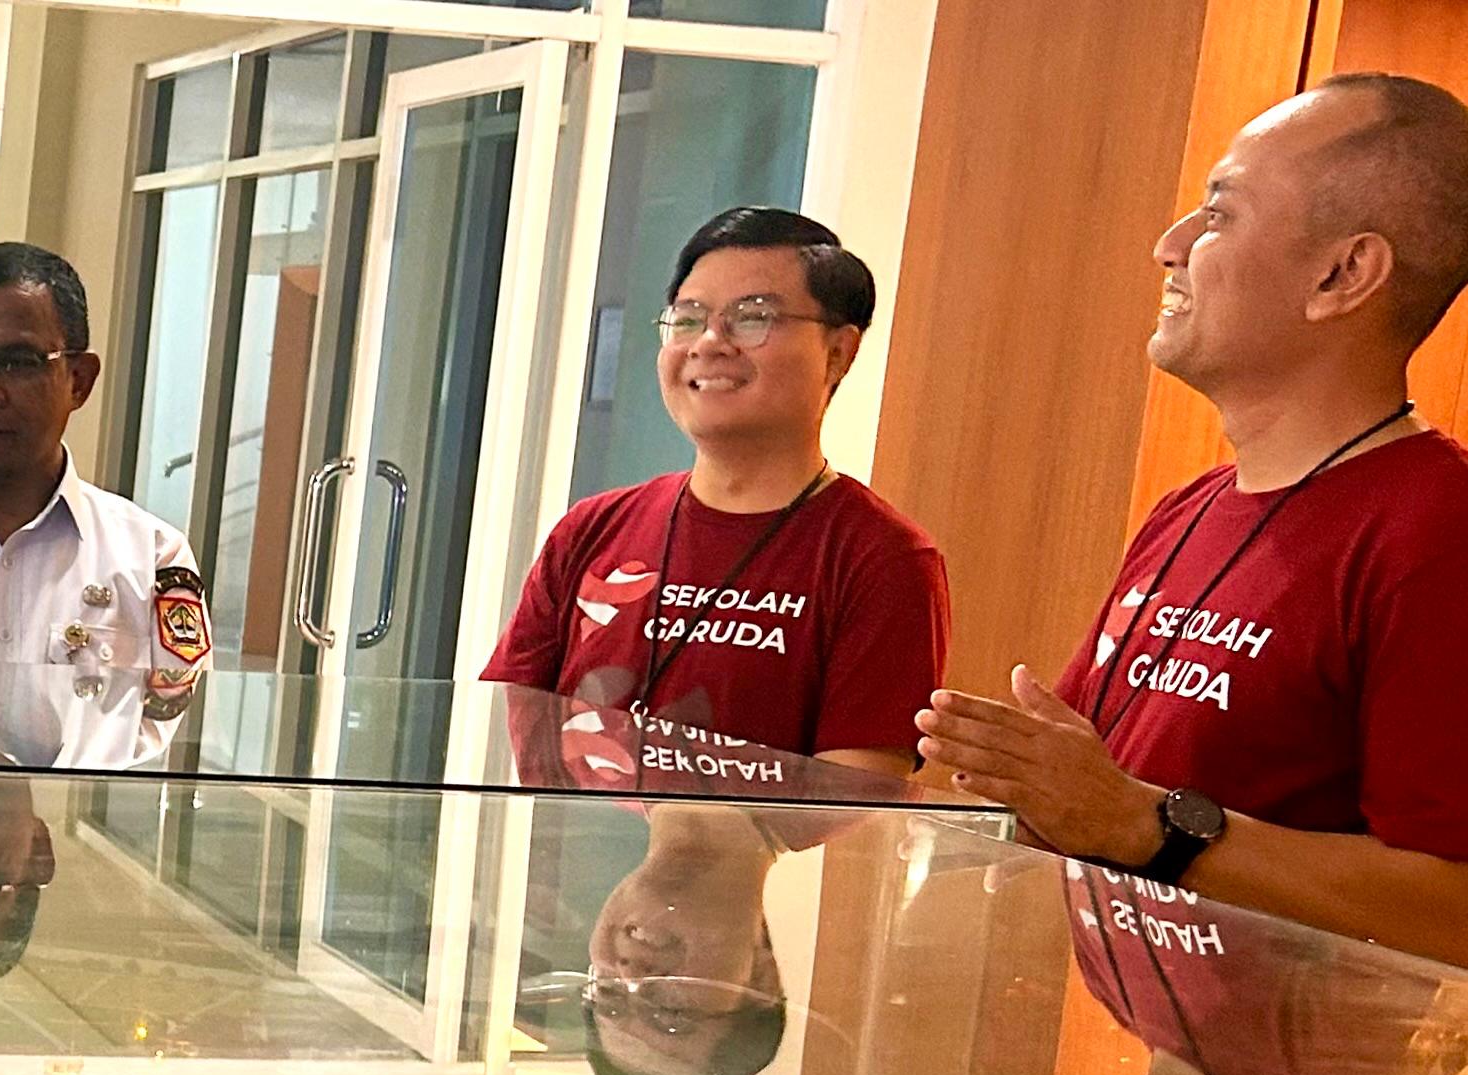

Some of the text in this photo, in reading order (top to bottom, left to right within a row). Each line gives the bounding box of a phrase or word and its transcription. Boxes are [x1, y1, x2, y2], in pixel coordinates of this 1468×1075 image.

[661, 584, 806, 618] SEKOLAH
[644, 617, 786, 655] GARUDA
[1149, 606, 1273, 659] SEKOLAH
[1128, 654, 1230, 711] GARUDA
